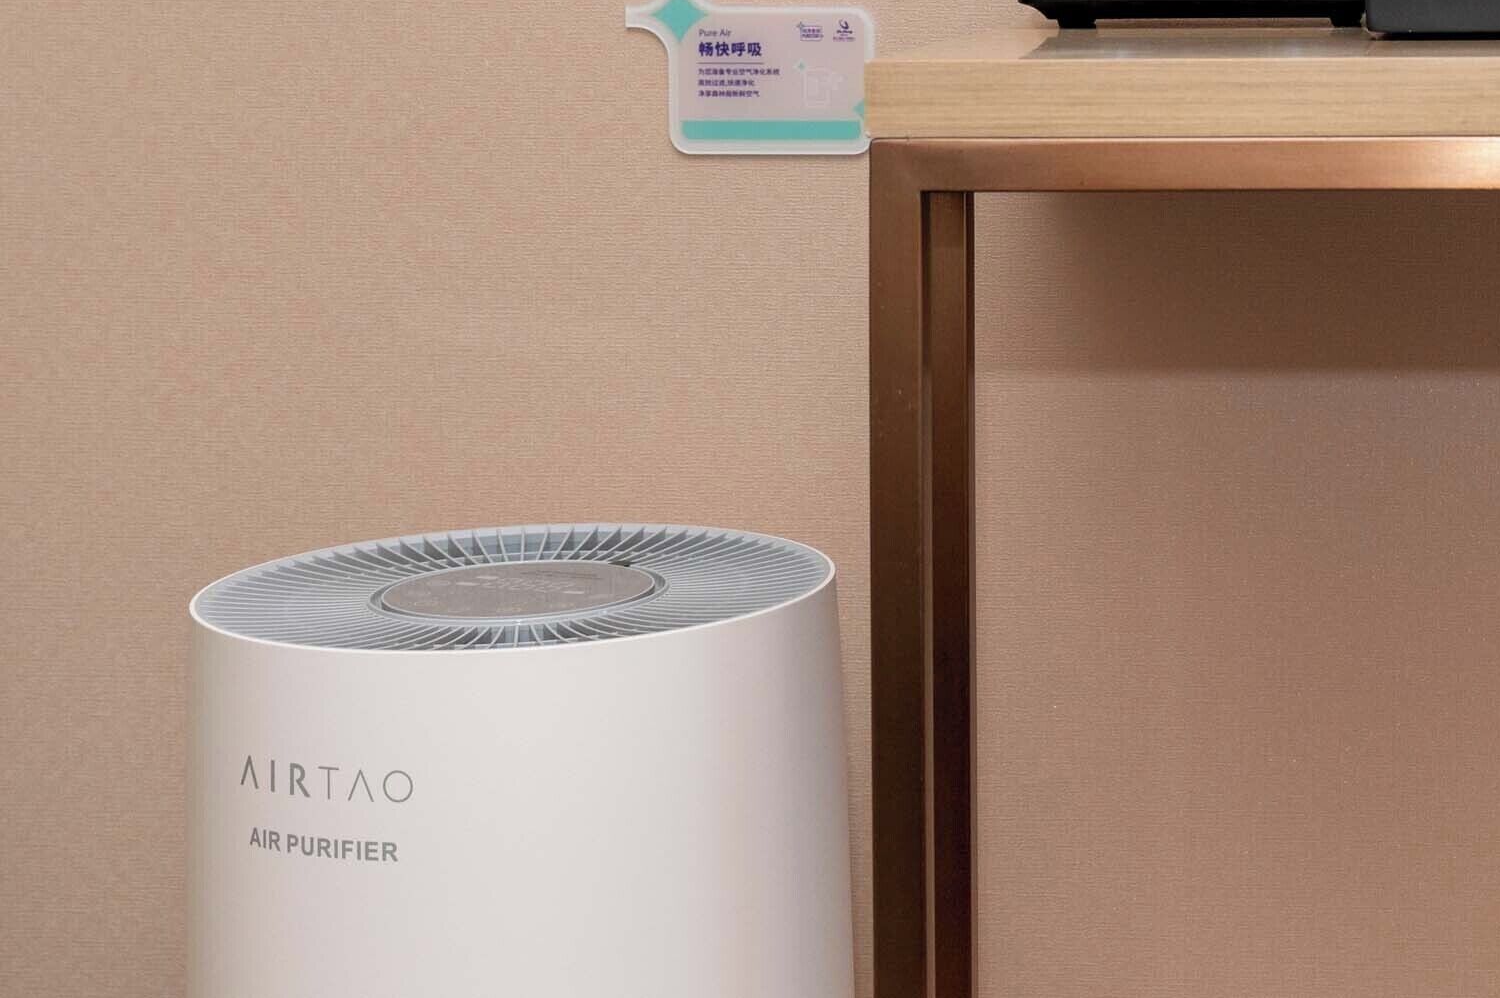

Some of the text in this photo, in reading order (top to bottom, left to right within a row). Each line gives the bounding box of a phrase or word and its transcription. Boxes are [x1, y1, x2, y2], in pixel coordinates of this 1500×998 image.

[699, 29, 717, 37] Pure
[698, 42, 762, 57] 畅快呼吸
[240, 754, 413, 803] AIRTAO
[250, 827, 398, 862] AIR PURIFIER
